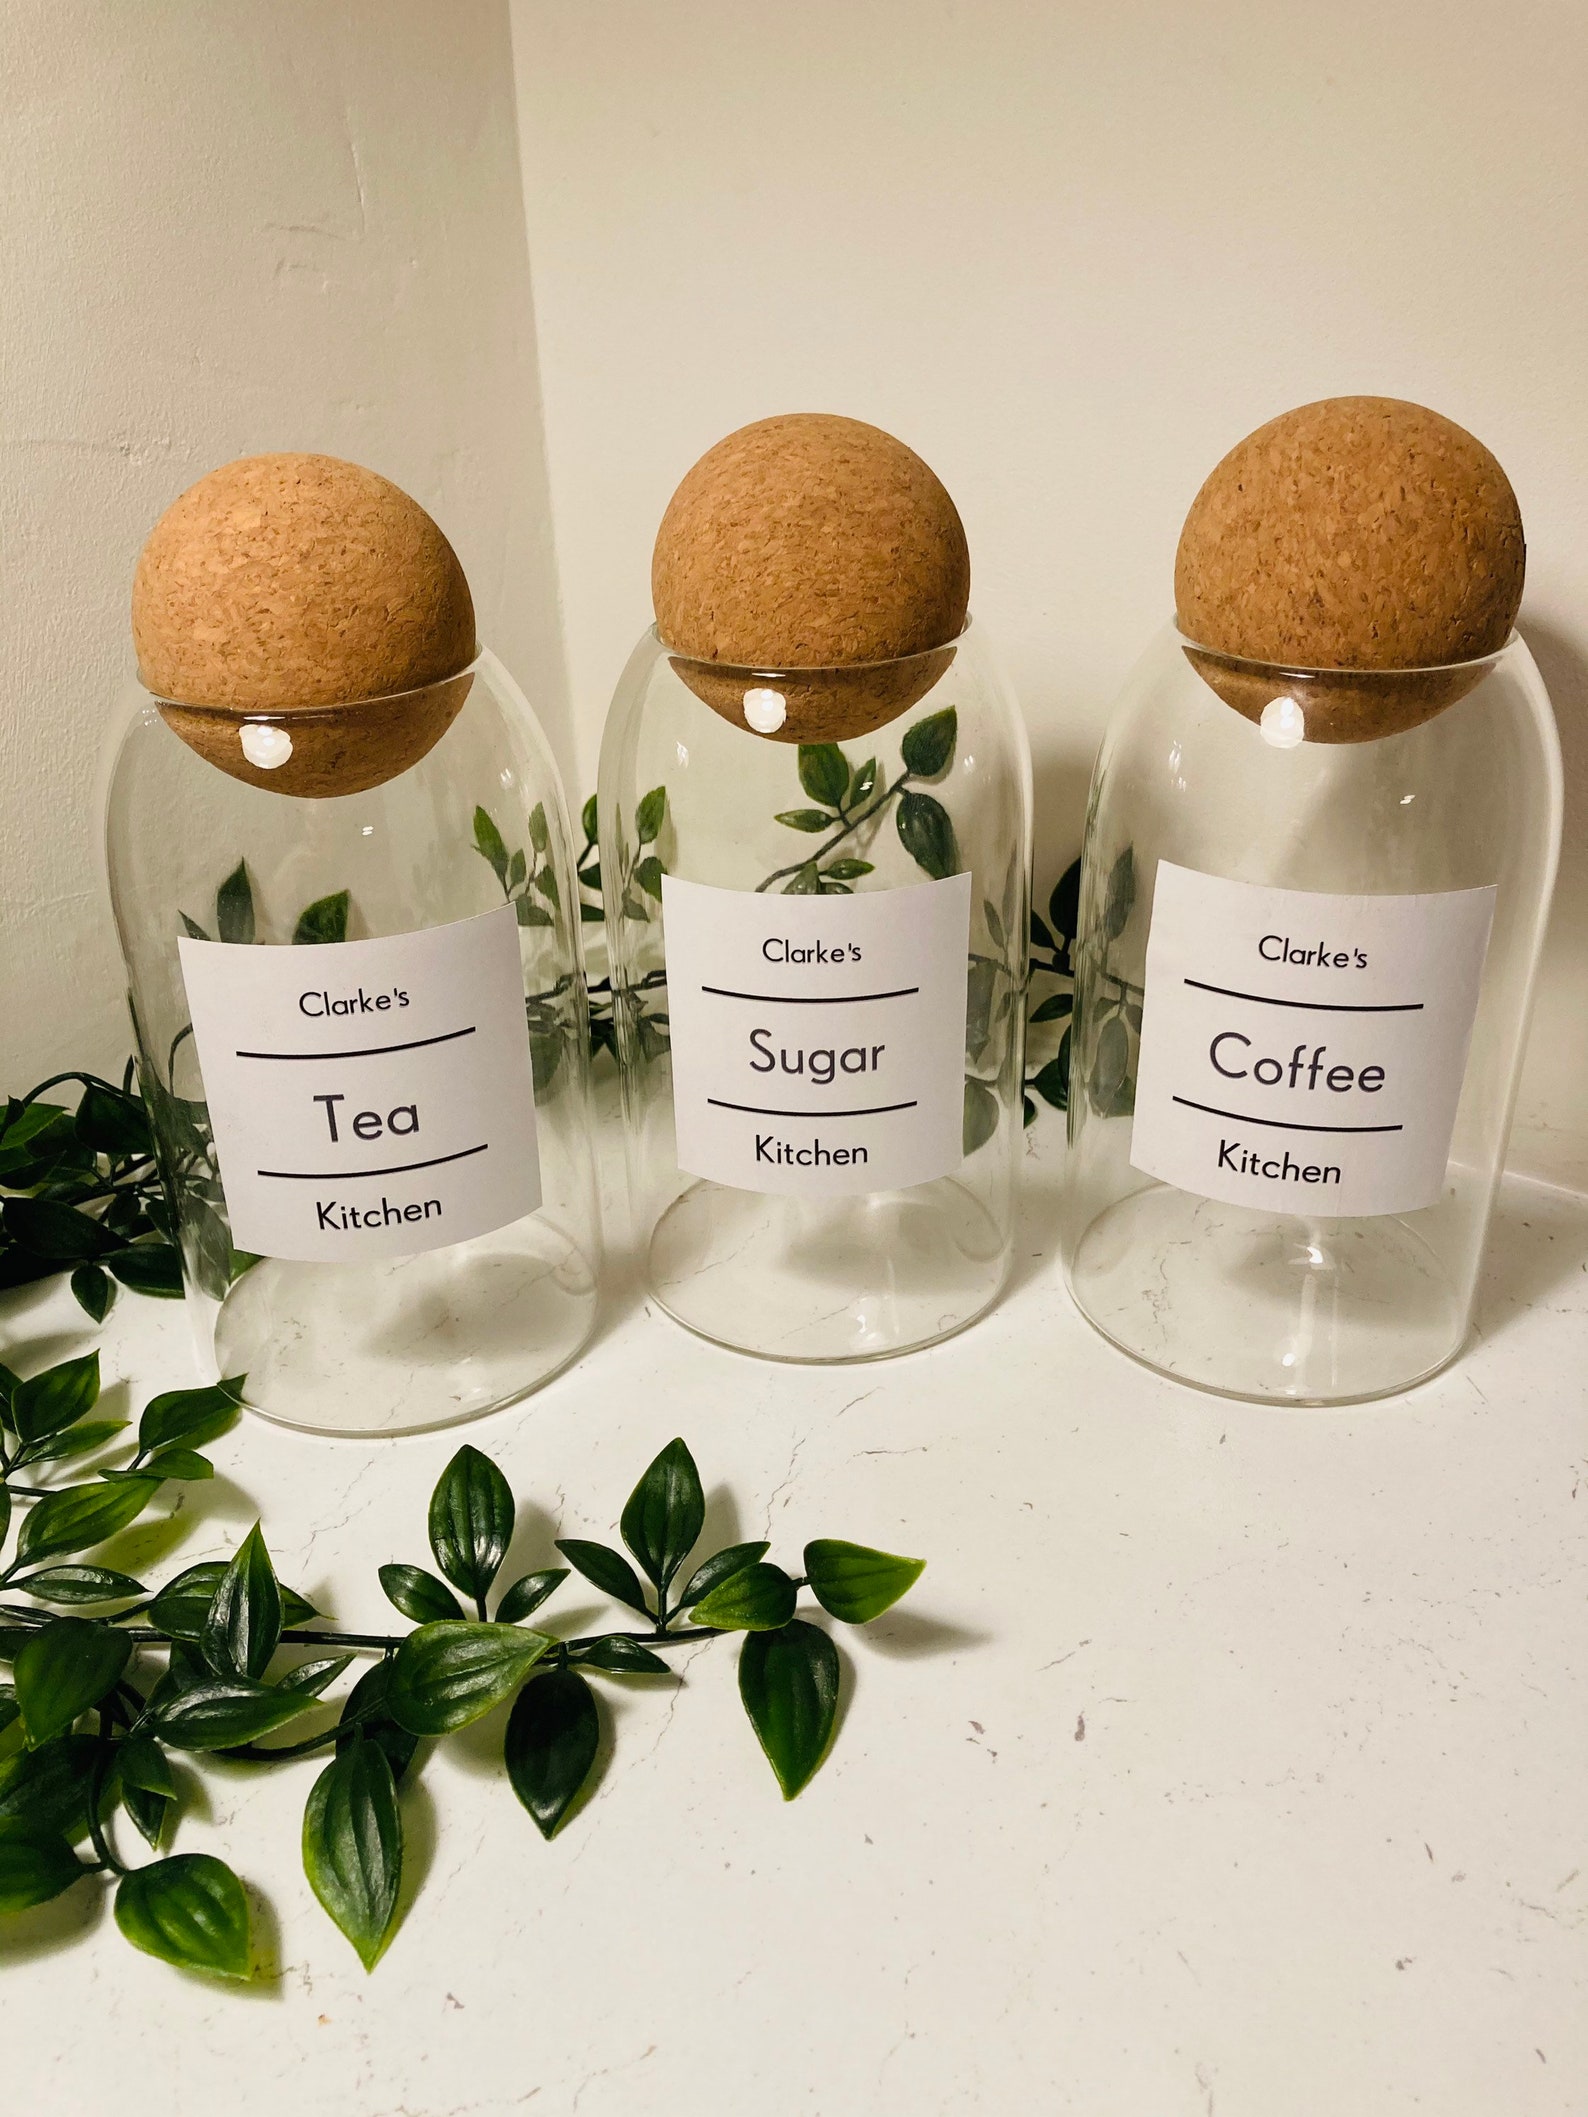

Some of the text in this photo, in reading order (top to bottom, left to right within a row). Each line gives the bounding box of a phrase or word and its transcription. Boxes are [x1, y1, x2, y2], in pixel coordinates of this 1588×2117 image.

[762, 937, 862, 964] Clarke's
[1258, 934, 1368, 970] Clarke's
[298, 987, 410, 1018] Clarke's
[749, 1028, 886, 1086] Sugar
[1209, 1031, 1386, 1094] Coffee
[312, 1093, 420, 1143] Tea
[755, 1134, 868, 1167] Kitchen
[1217, 1138, 1342, 1185] Kitchen
[315, 1196, 443, 1231] Kitchen
